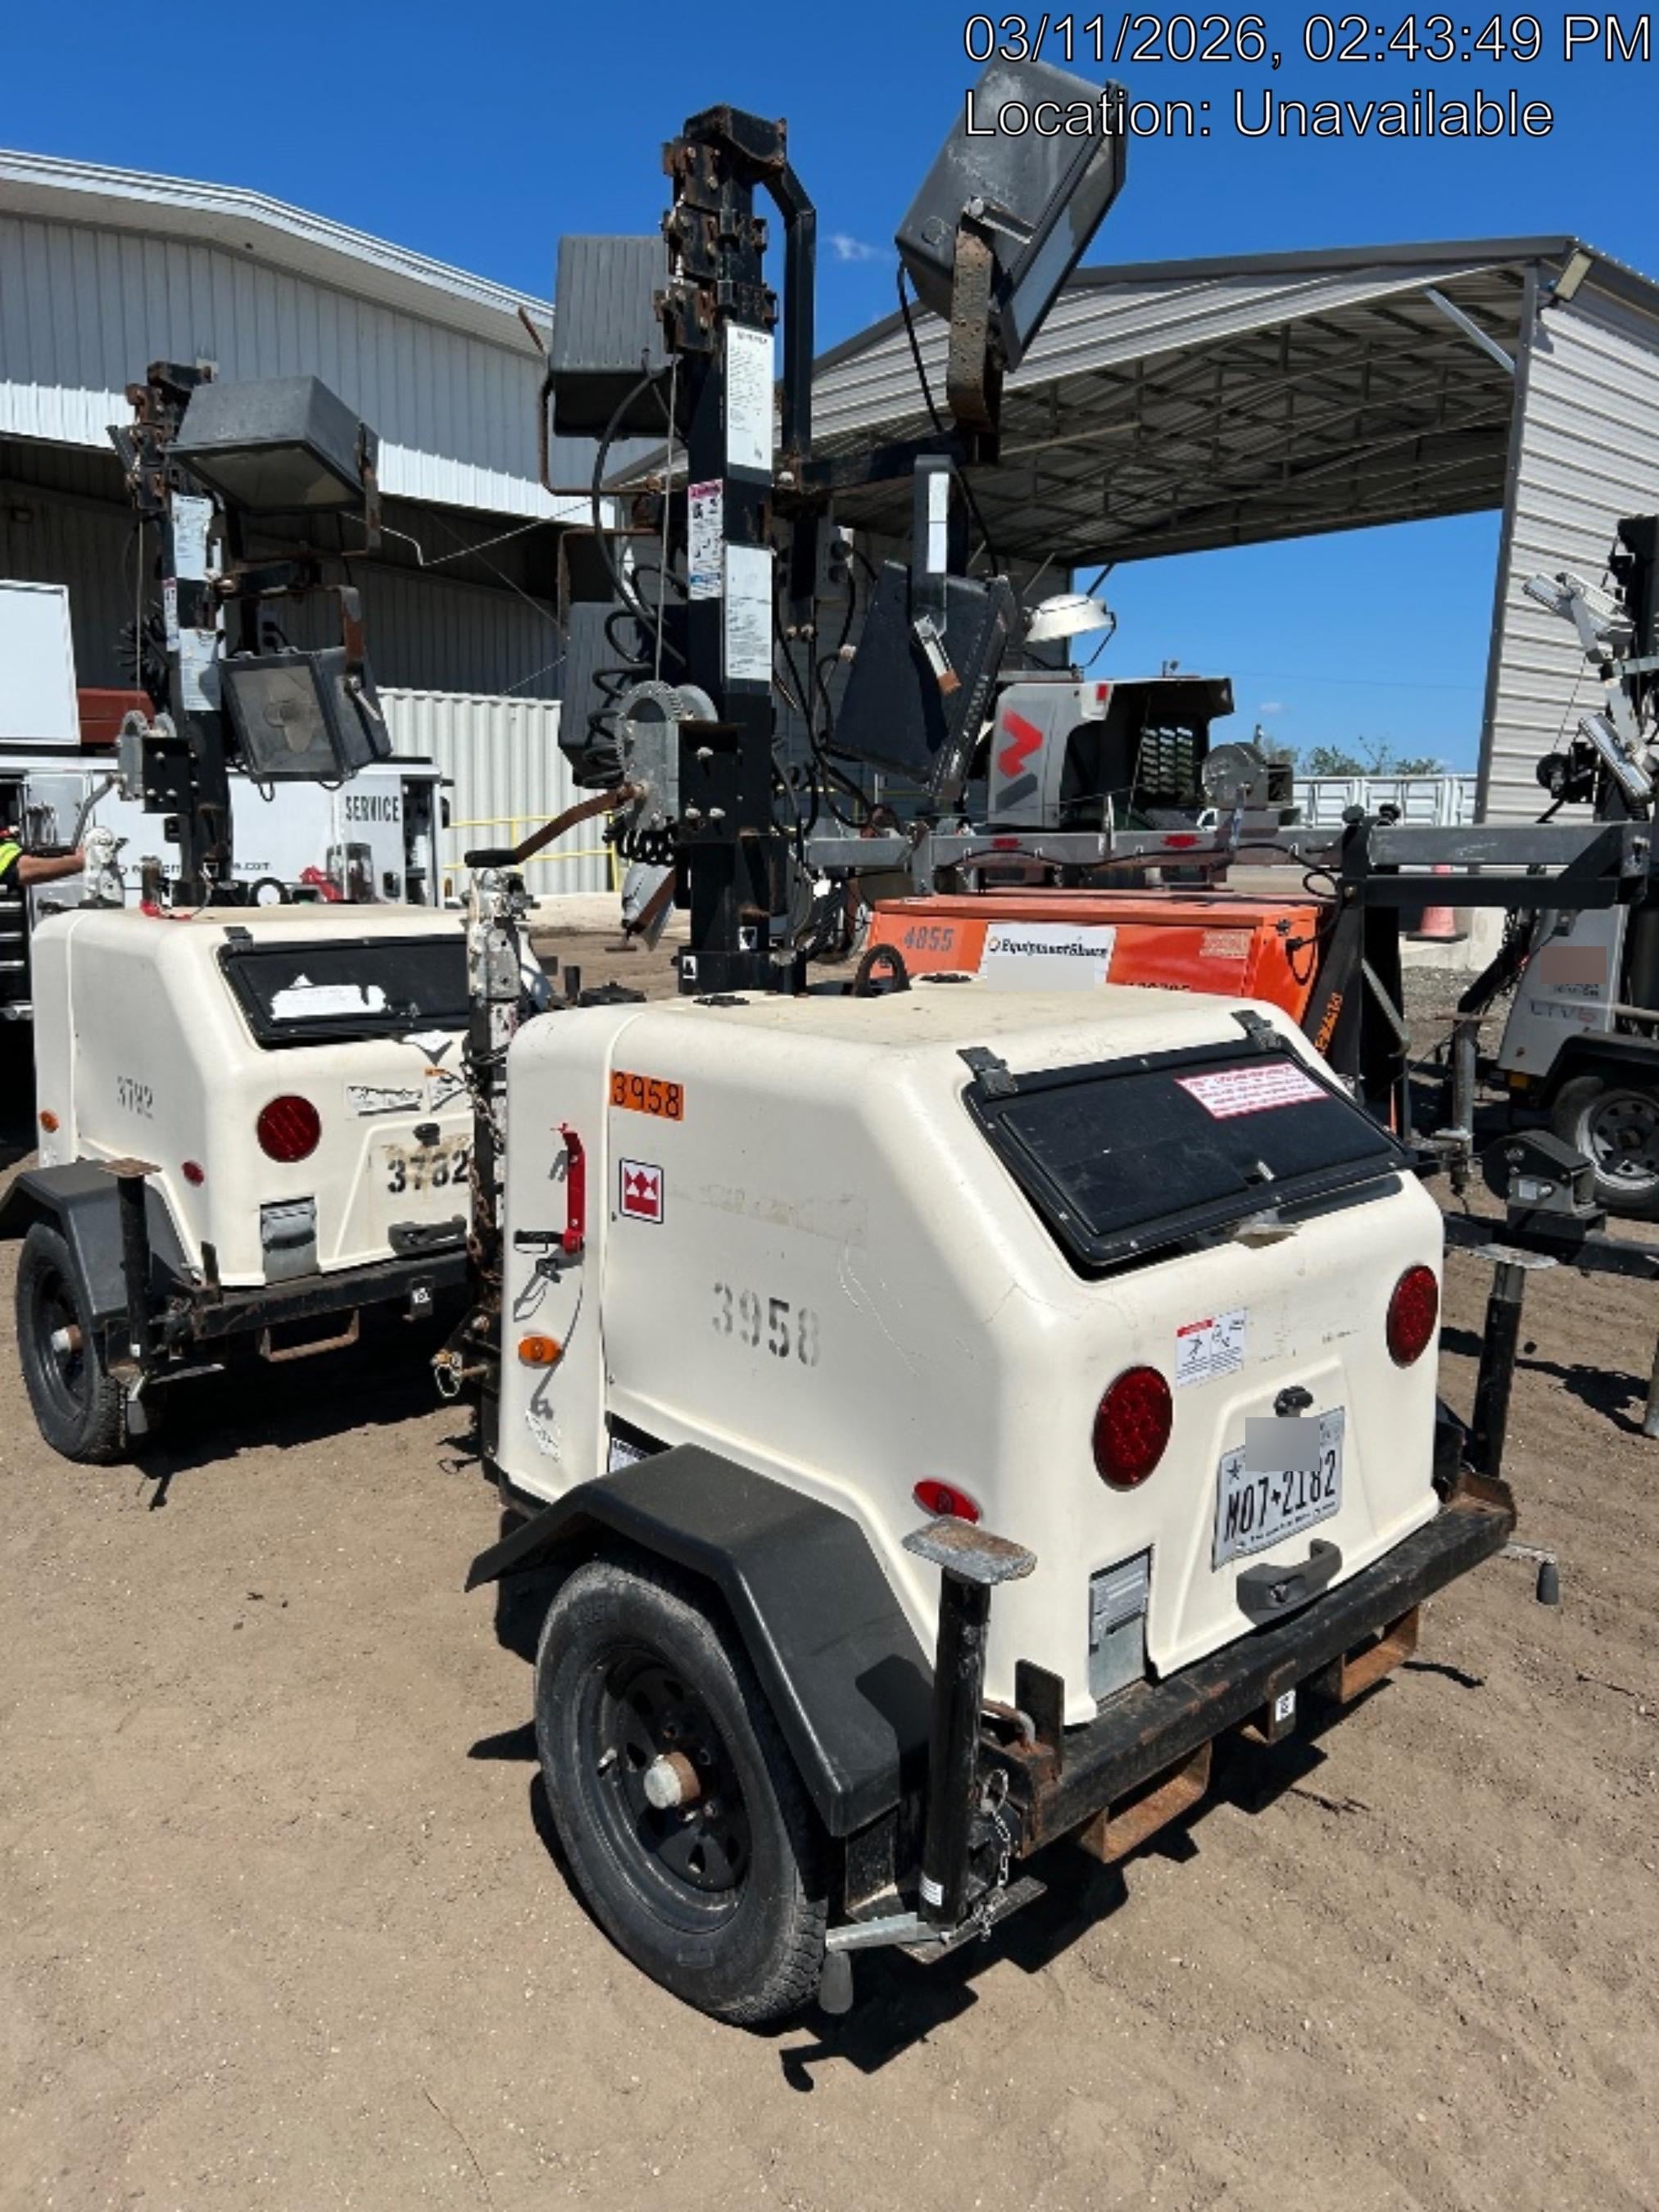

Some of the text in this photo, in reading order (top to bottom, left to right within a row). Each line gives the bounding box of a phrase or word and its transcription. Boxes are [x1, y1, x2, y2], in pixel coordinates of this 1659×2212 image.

[346, 796, 400, 821] SERVICE
[614, 1071, 679, 1117] 3958
[712, 1281, 819, 1367] 3958
